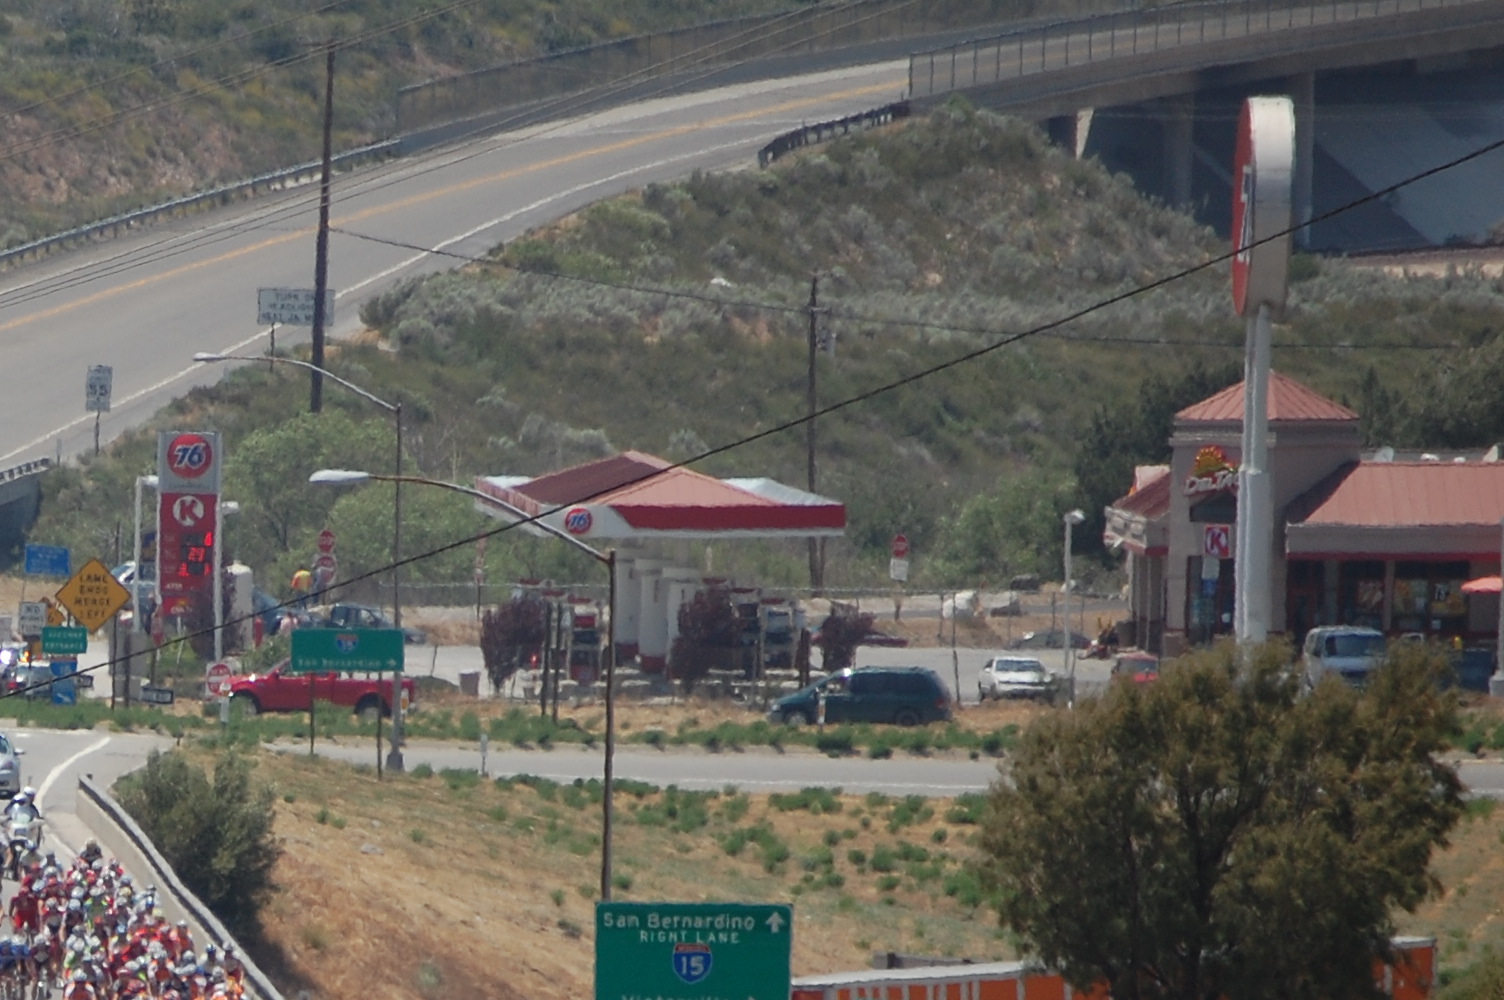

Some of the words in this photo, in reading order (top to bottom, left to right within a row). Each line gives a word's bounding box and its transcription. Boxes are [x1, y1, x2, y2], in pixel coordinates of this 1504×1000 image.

[174, 442, 206, 470] 76
[177, 497, 203, 524] K
[568, 512, 589, 528] 76
[1209, 528, 1227, 554] K
[603, 912, 639, 929] San
[647, 913, 755, 930] Bernardino
[640, 930, 687, 943] RIGHT
[696, 931, 740, 944] LANE
[681, 956, 705, 976] 15
